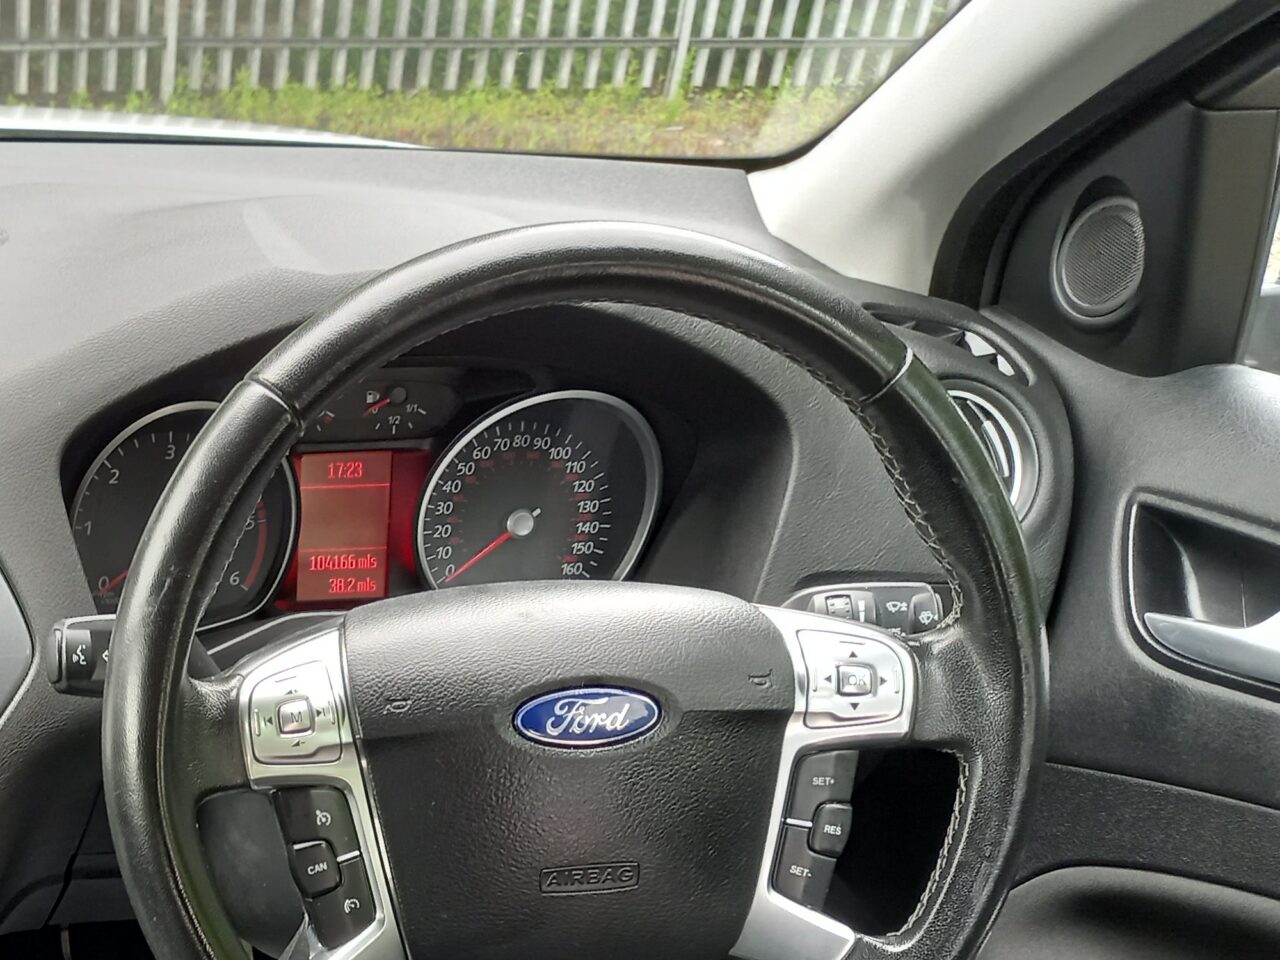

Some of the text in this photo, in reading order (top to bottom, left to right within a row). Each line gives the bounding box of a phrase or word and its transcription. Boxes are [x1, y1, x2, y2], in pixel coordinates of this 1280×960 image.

[493, 438, 511, 451] 70
[512, 434, 530, 448] 80
[533, 437, 551, 450] 90
[164, 444, 176, 460] 3
[472, 446, 491, 460] 60
[548, 446, 572, 460] 100
[327, 461, 363, 479] 17:23
[456, 462, 476, 475] 50
[565, 461, 586, 474] 110
[108, 469, 119, 485] 2
[442, 480, 462, 494] 40
[572, 479, 595, 493] 120
[435, 501, 454, 515] 30
[577, 500, 600, 513] 130
[83, 520, 92, 535] 1
[433, 524, 452, 538] 20
[575, 521, 599, 534] 140
[435, 546, 453, 559] 10
[571, 541, 594, 555] 150
[309, 554, 356, 571] 104166
[561, 562, 583, 576] 160
[445, 564, 456, 578] 0
[229, 571, 240, 586] 6
[328, 577, 355, 593] 38.2
[847, 673, 867, 687] OK
[290, 710, 303, 724] M
[545, 697, 631, 737] Ford
[824, 823, 842, 836] RES
[306, 860, 328, 876] CAN
[546, 866, 634, 888] AIRBAG
